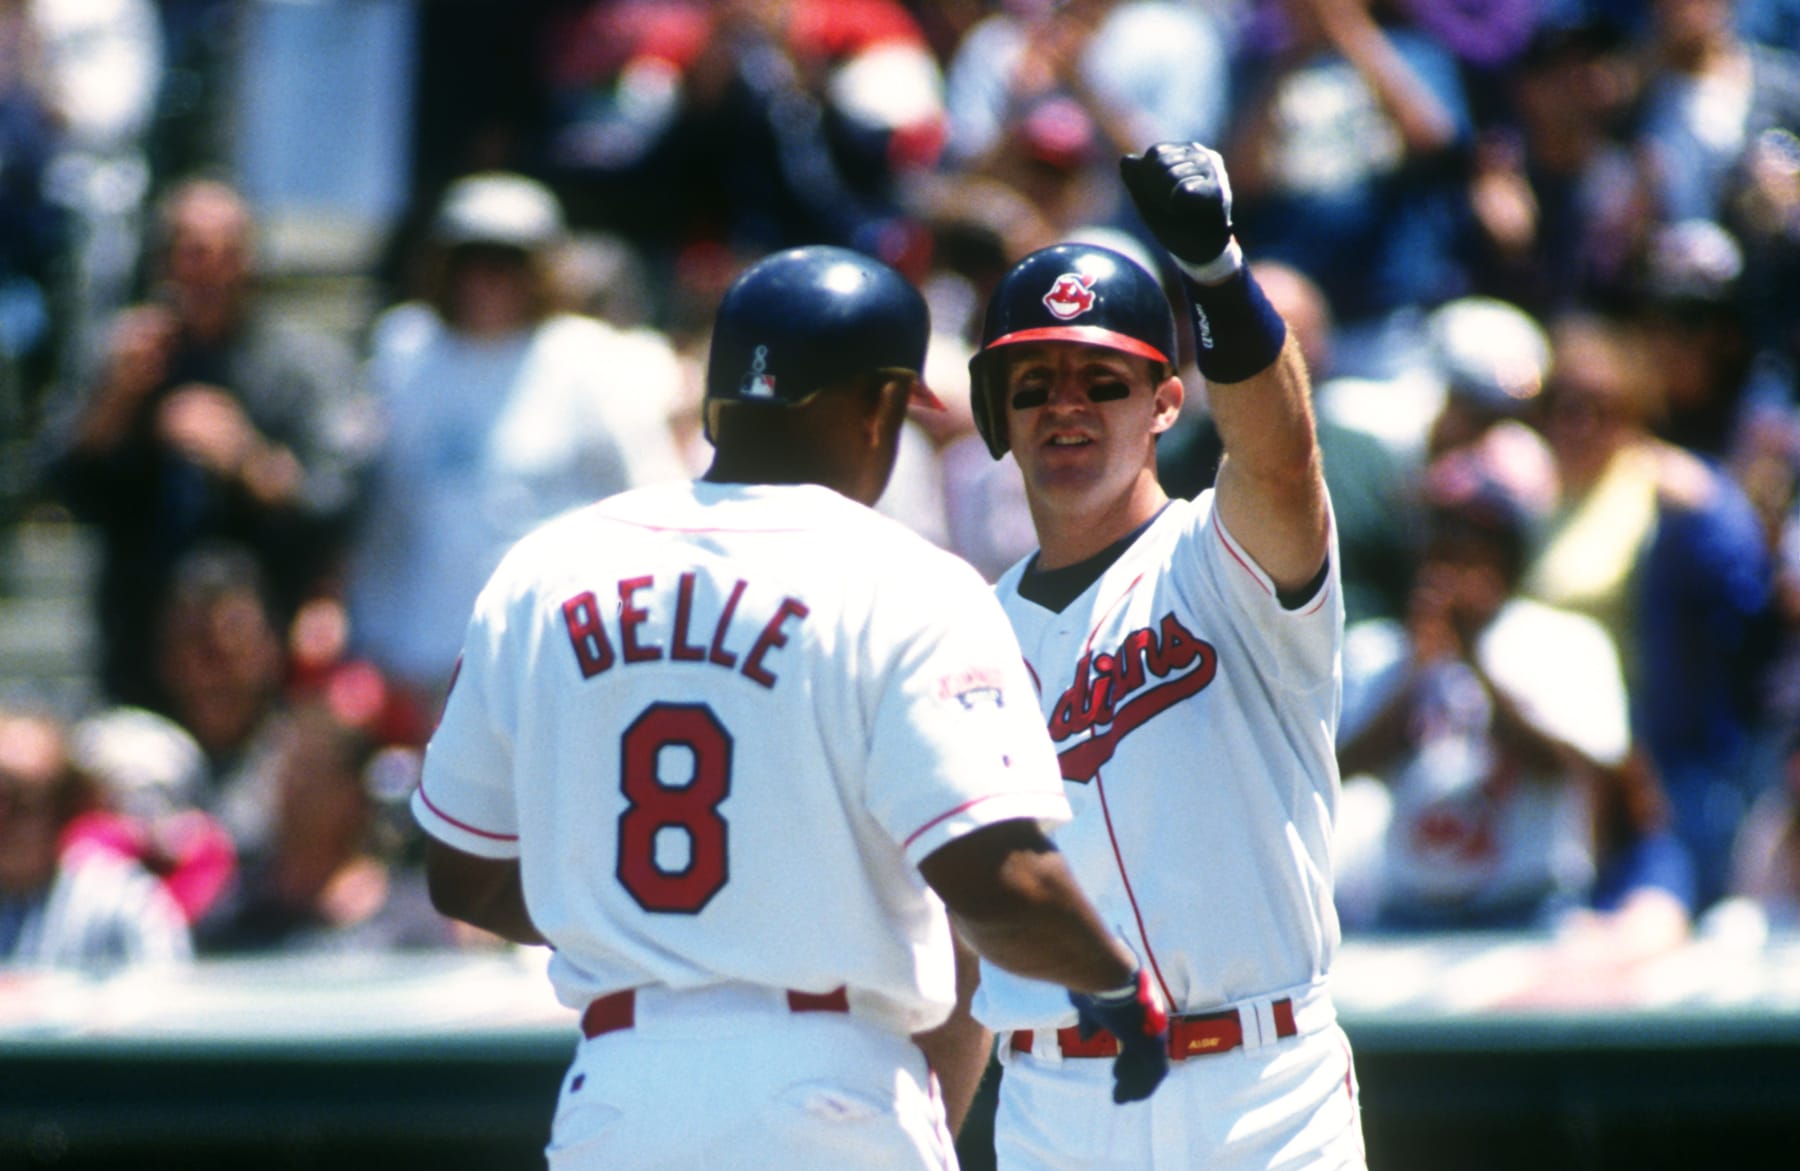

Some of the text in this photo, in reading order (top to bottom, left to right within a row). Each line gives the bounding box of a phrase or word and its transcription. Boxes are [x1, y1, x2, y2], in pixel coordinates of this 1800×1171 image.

[752, 344, 768, 372] 8
[562, 572, 810, 689] BELLE
[616, 700, 734, 914] 8
